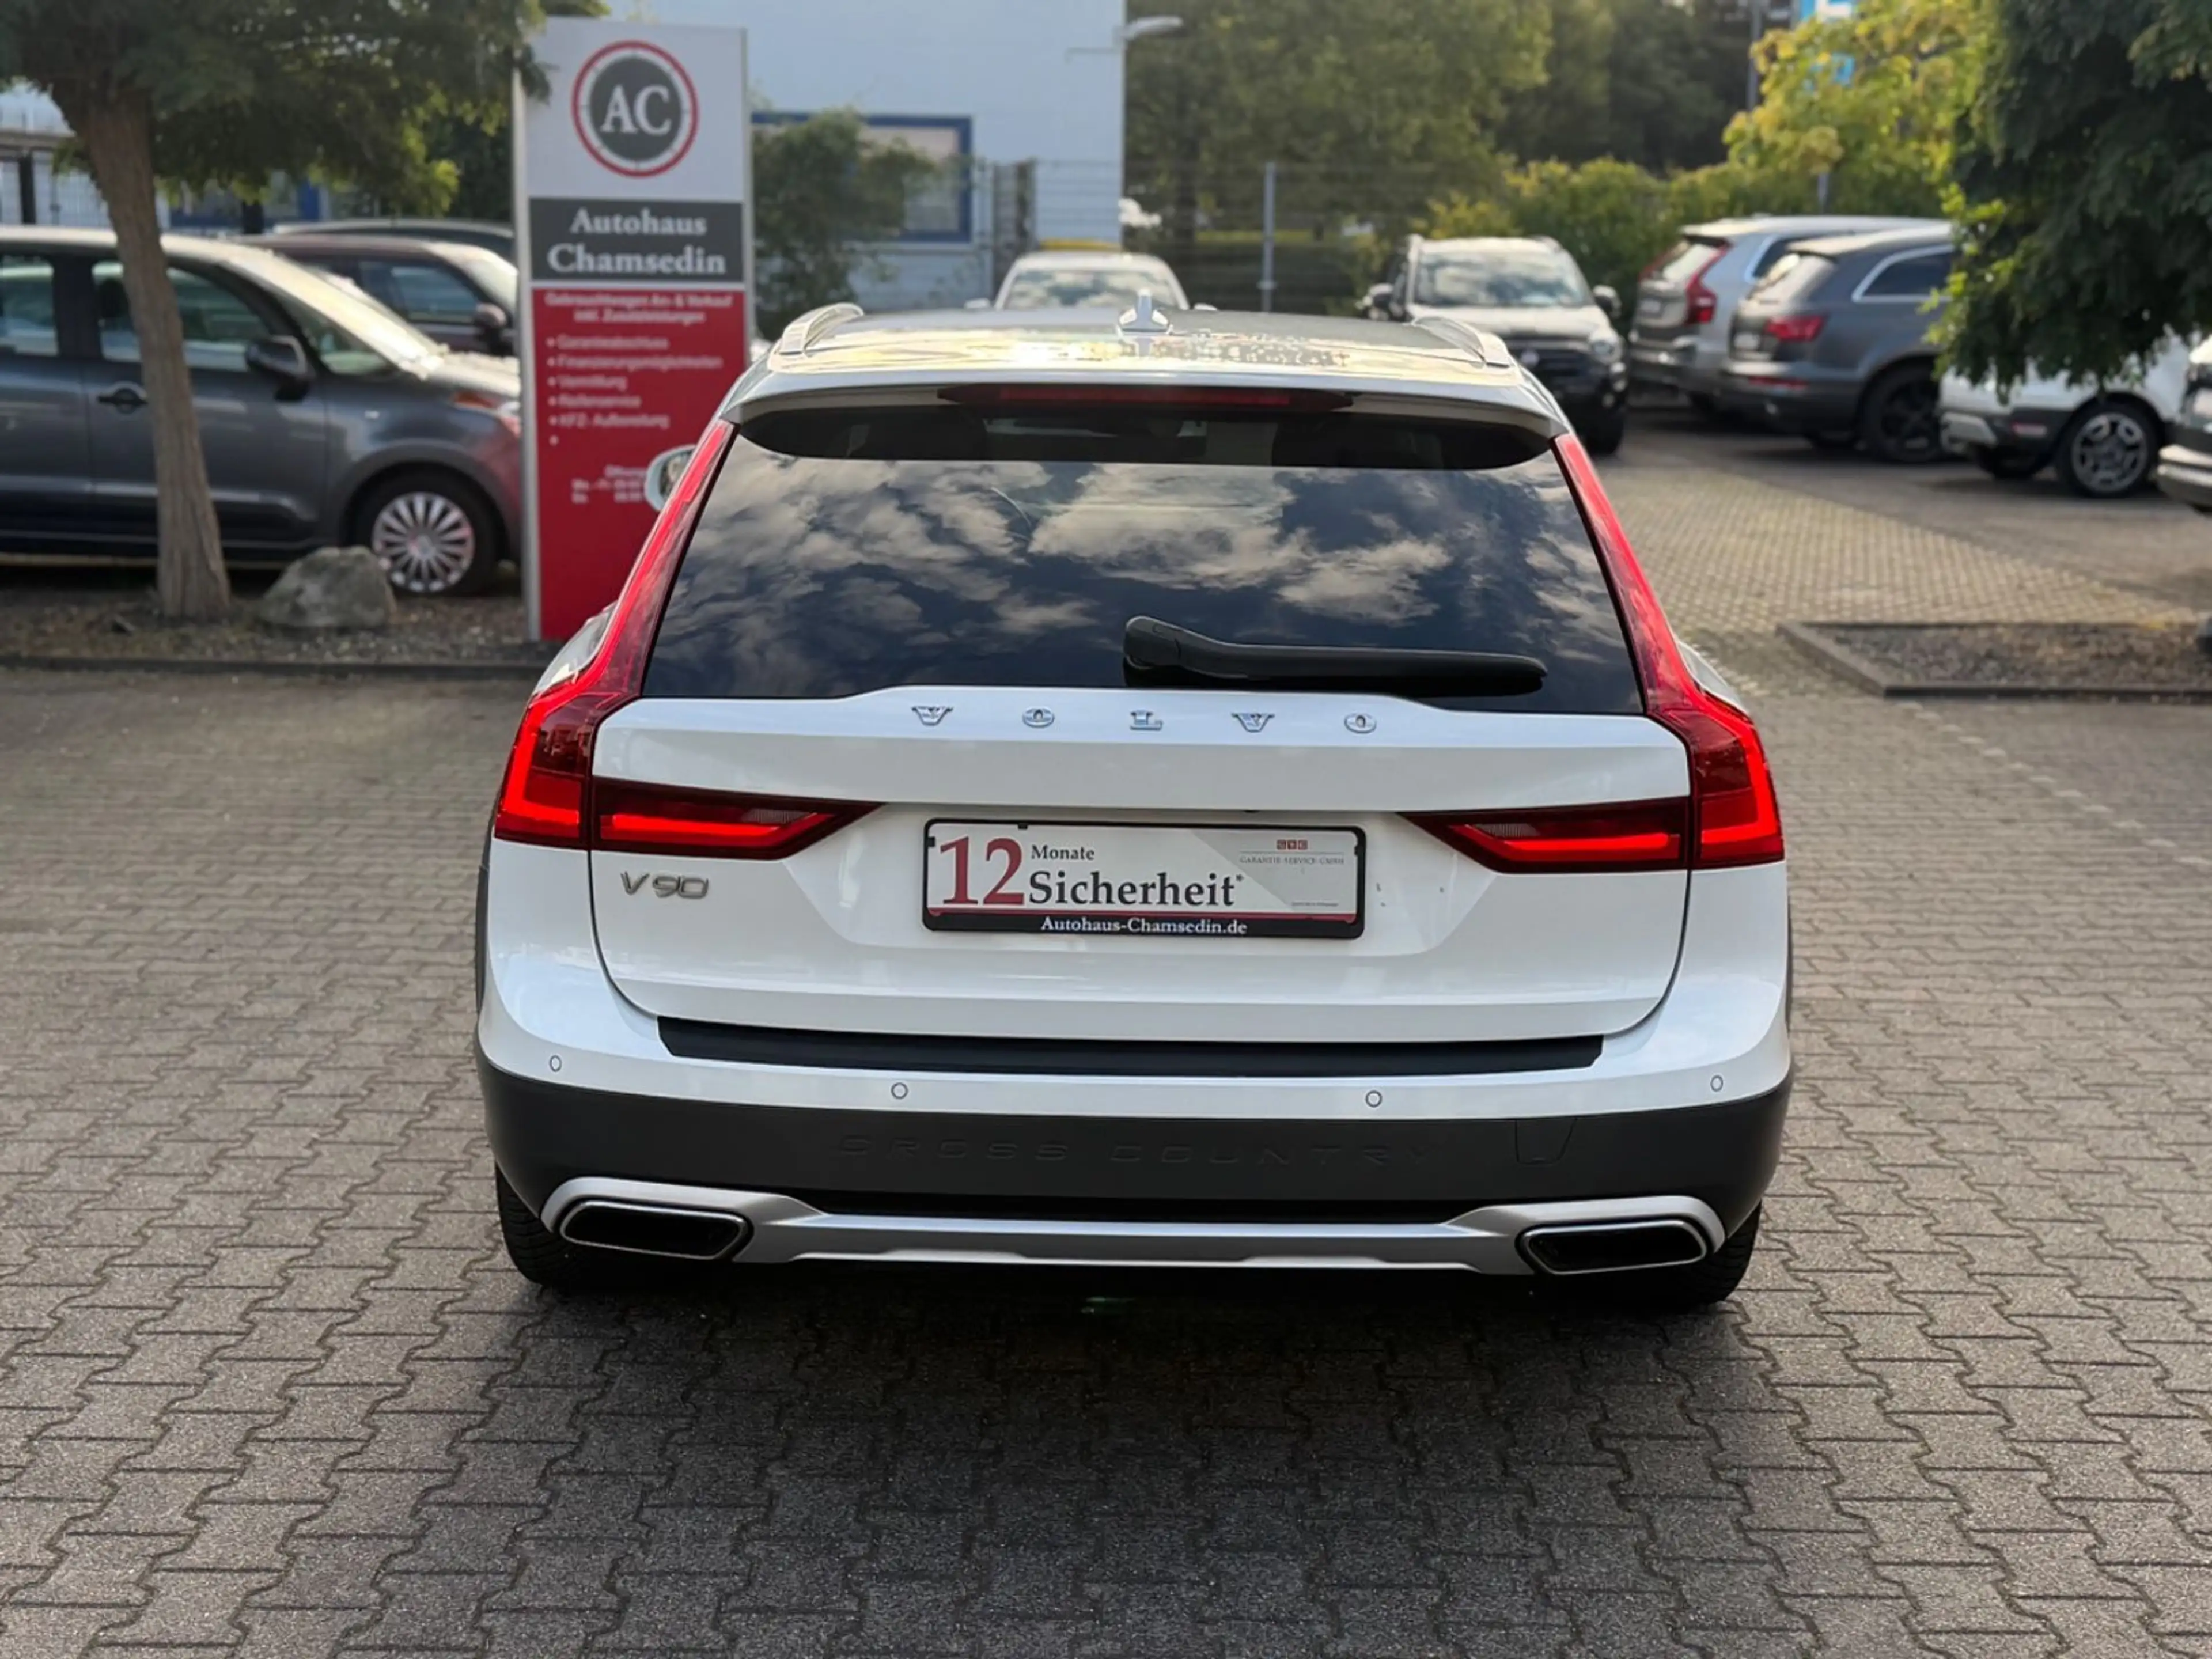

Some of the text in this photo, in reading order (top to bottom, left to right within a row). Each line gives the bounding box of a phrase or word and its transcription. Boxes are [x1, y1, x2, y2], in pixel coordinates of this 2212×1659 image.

[600, 84, 672, 136] AC
[570, 207, 708, 236] Autohaus
[547, 242, 726, 275] Chamsedin
[911, 704, 1377, 733] VOLVO
[1031, 844, 1095, 861] Monate
[940, 836, 1025, 905] 12
[620, 871, 709, 900] V90
[1041, 915, 1248, 936] Autohaus-Chamsedin.de
[840, 1134, 1438, 1166] CROSS COUNTRY
